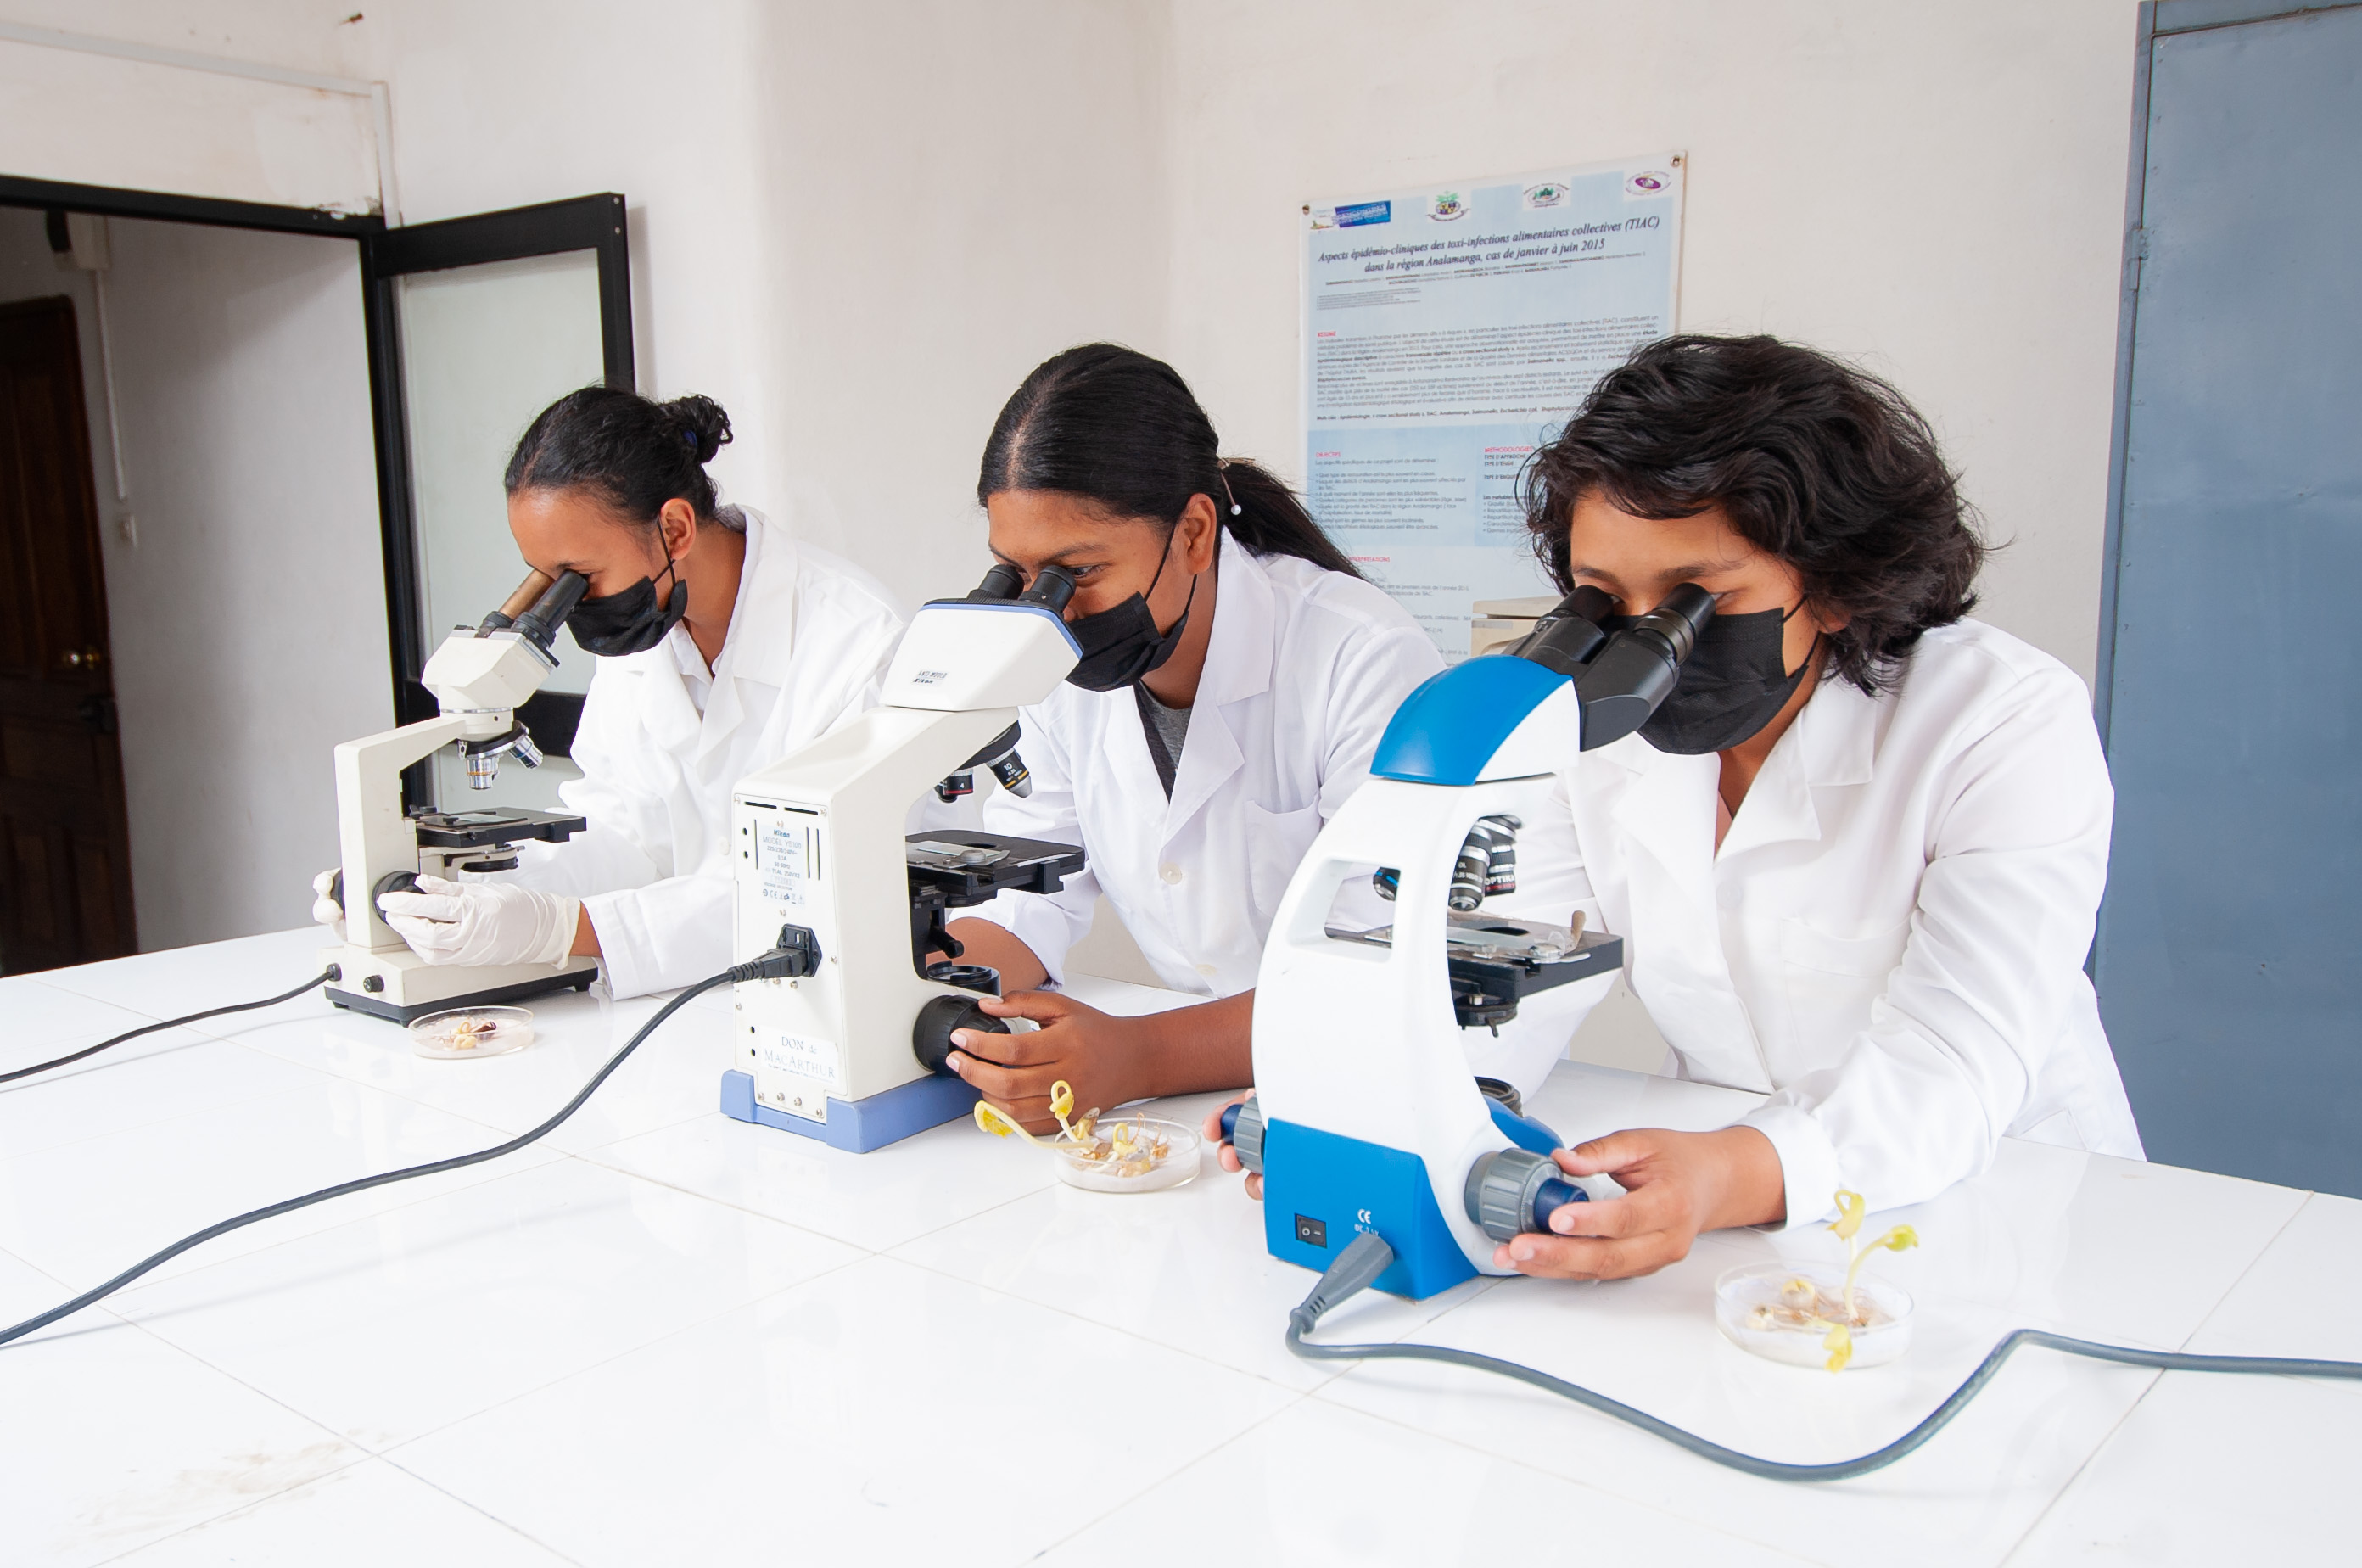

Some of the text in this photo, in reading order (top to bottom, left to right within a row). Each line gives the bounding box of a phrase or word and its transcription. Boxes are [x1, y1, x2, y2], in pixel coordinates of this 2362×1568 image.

[1318, 252, 1348, 263] Aspects
[1430, 239, 1445, 250] des
[1447, 234, 1509, 248] toxi-infections
[1512, 228, 1569, 241] alimentaires
[1571, 222, 1621, 235] collectives
[1625, 216, 1660, 231] (TIAC)
[1364, 261, 1384, 272] dans
[1385, 260, 1395, 270] la
[1396, 258, 1424, 271] région
[1425, 254, 1482, 266] Analamanga,
[1486, 251, 1501, 260] cas
[1503, 247, 1514, 258] de
[1514, 245, 1549, 260] janvier
[1551, 243, 1558, 254] à
[1558, 242, 1578, 255] juin
[1581, 238, 1605, 251] 2015
[773, 829, 791, 838] Nikon
[781, 1036, 803, 1050] DON
[1357, 1208, 1372, 1225] CE
